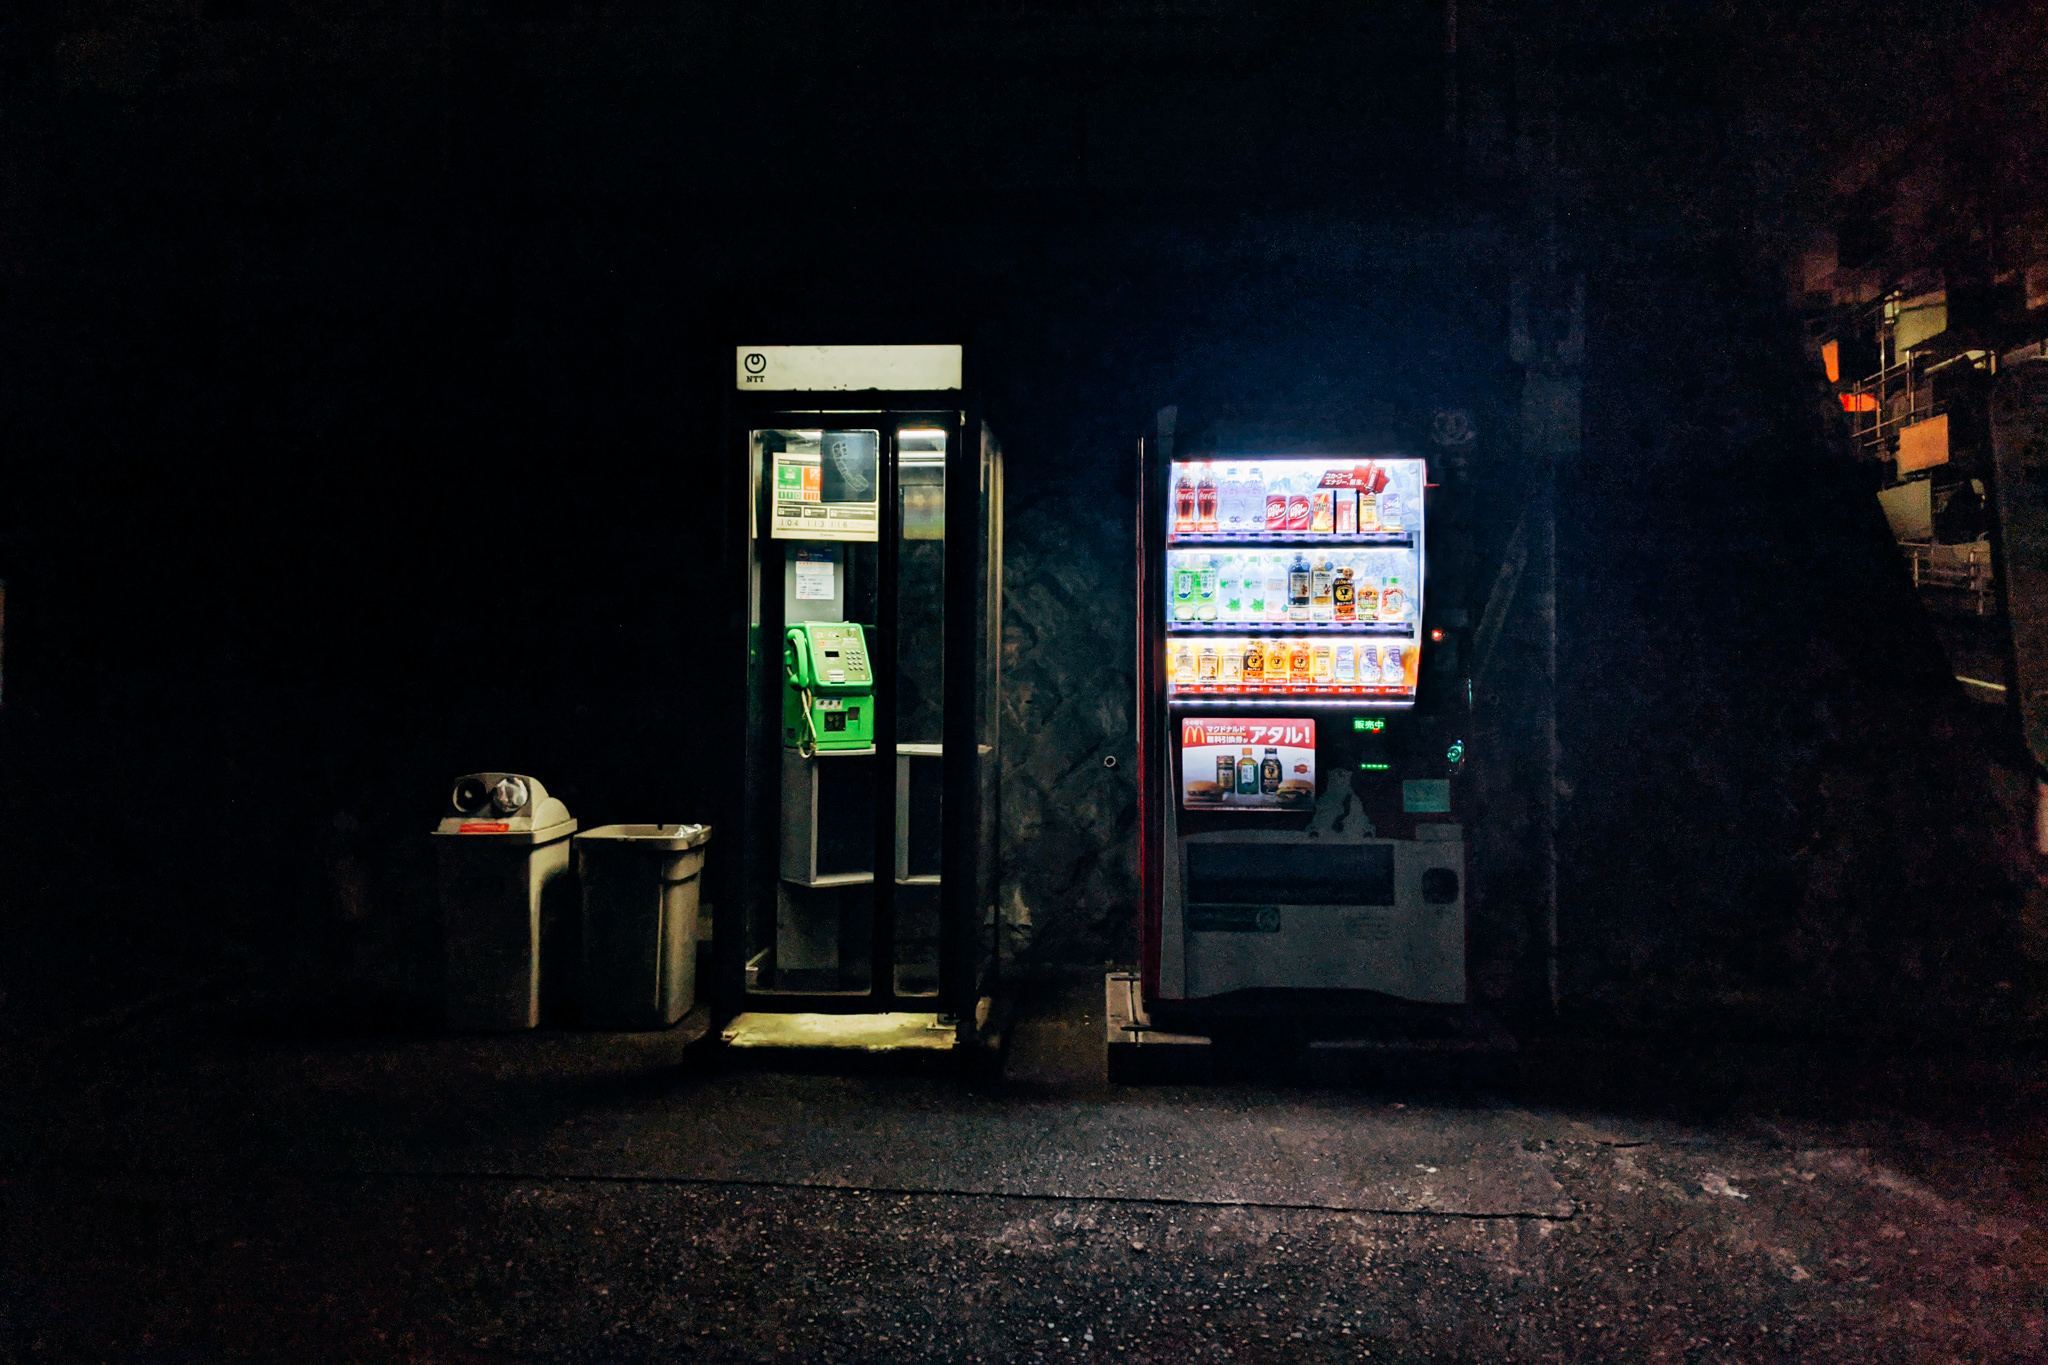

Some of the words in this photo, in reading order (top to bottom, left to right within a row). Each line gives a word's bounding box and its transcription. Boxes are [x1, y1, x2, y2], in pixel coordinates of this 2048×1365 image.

[746, 375, 765, 383] NTT
[830, 520, 848, 528] 116
[1206, 725, 1246, 733] マクドナルド
[1354, 720, 1384, 730] 販売中
